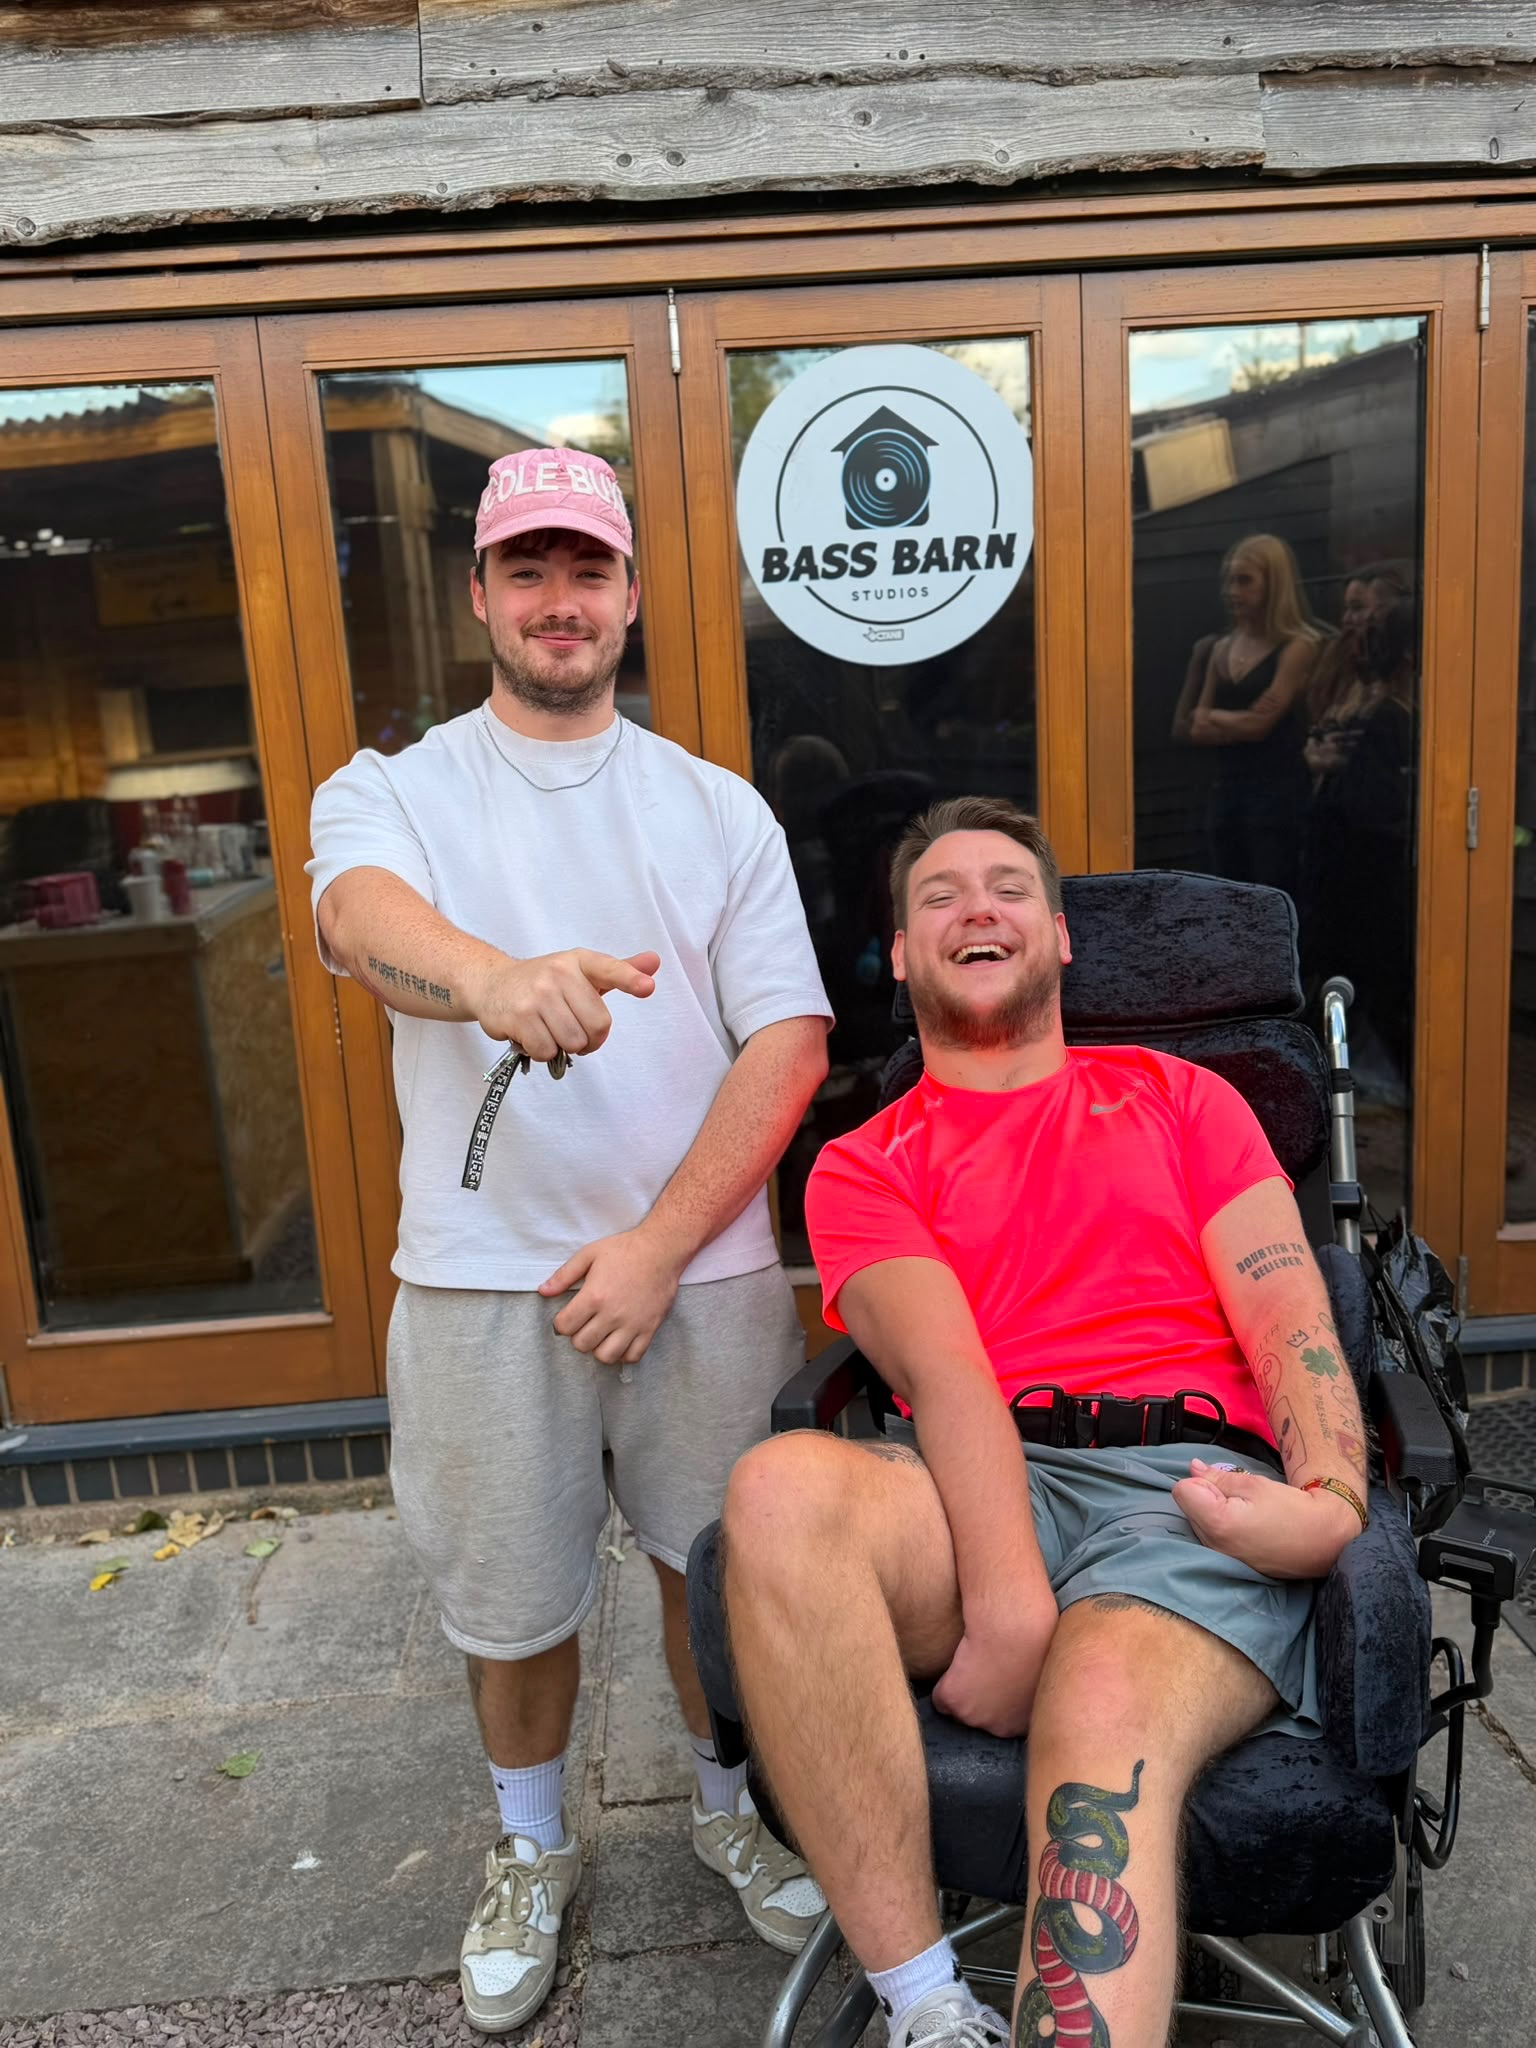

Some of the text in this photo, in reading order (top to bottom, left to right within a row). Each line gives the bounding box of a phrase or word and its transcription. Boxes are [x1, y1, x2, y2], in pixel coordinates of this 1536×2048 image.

[762, 533, 1017, 584] BASS BARN
[851, 586, 930, 602] STUDIOS
[1236, 1242, 1305, 1275] DOUBTER TO
[1251, 1256, 1304, 1282] BELIEVER
[1311, 1376, 1331, 1441] NO PRESSURE
